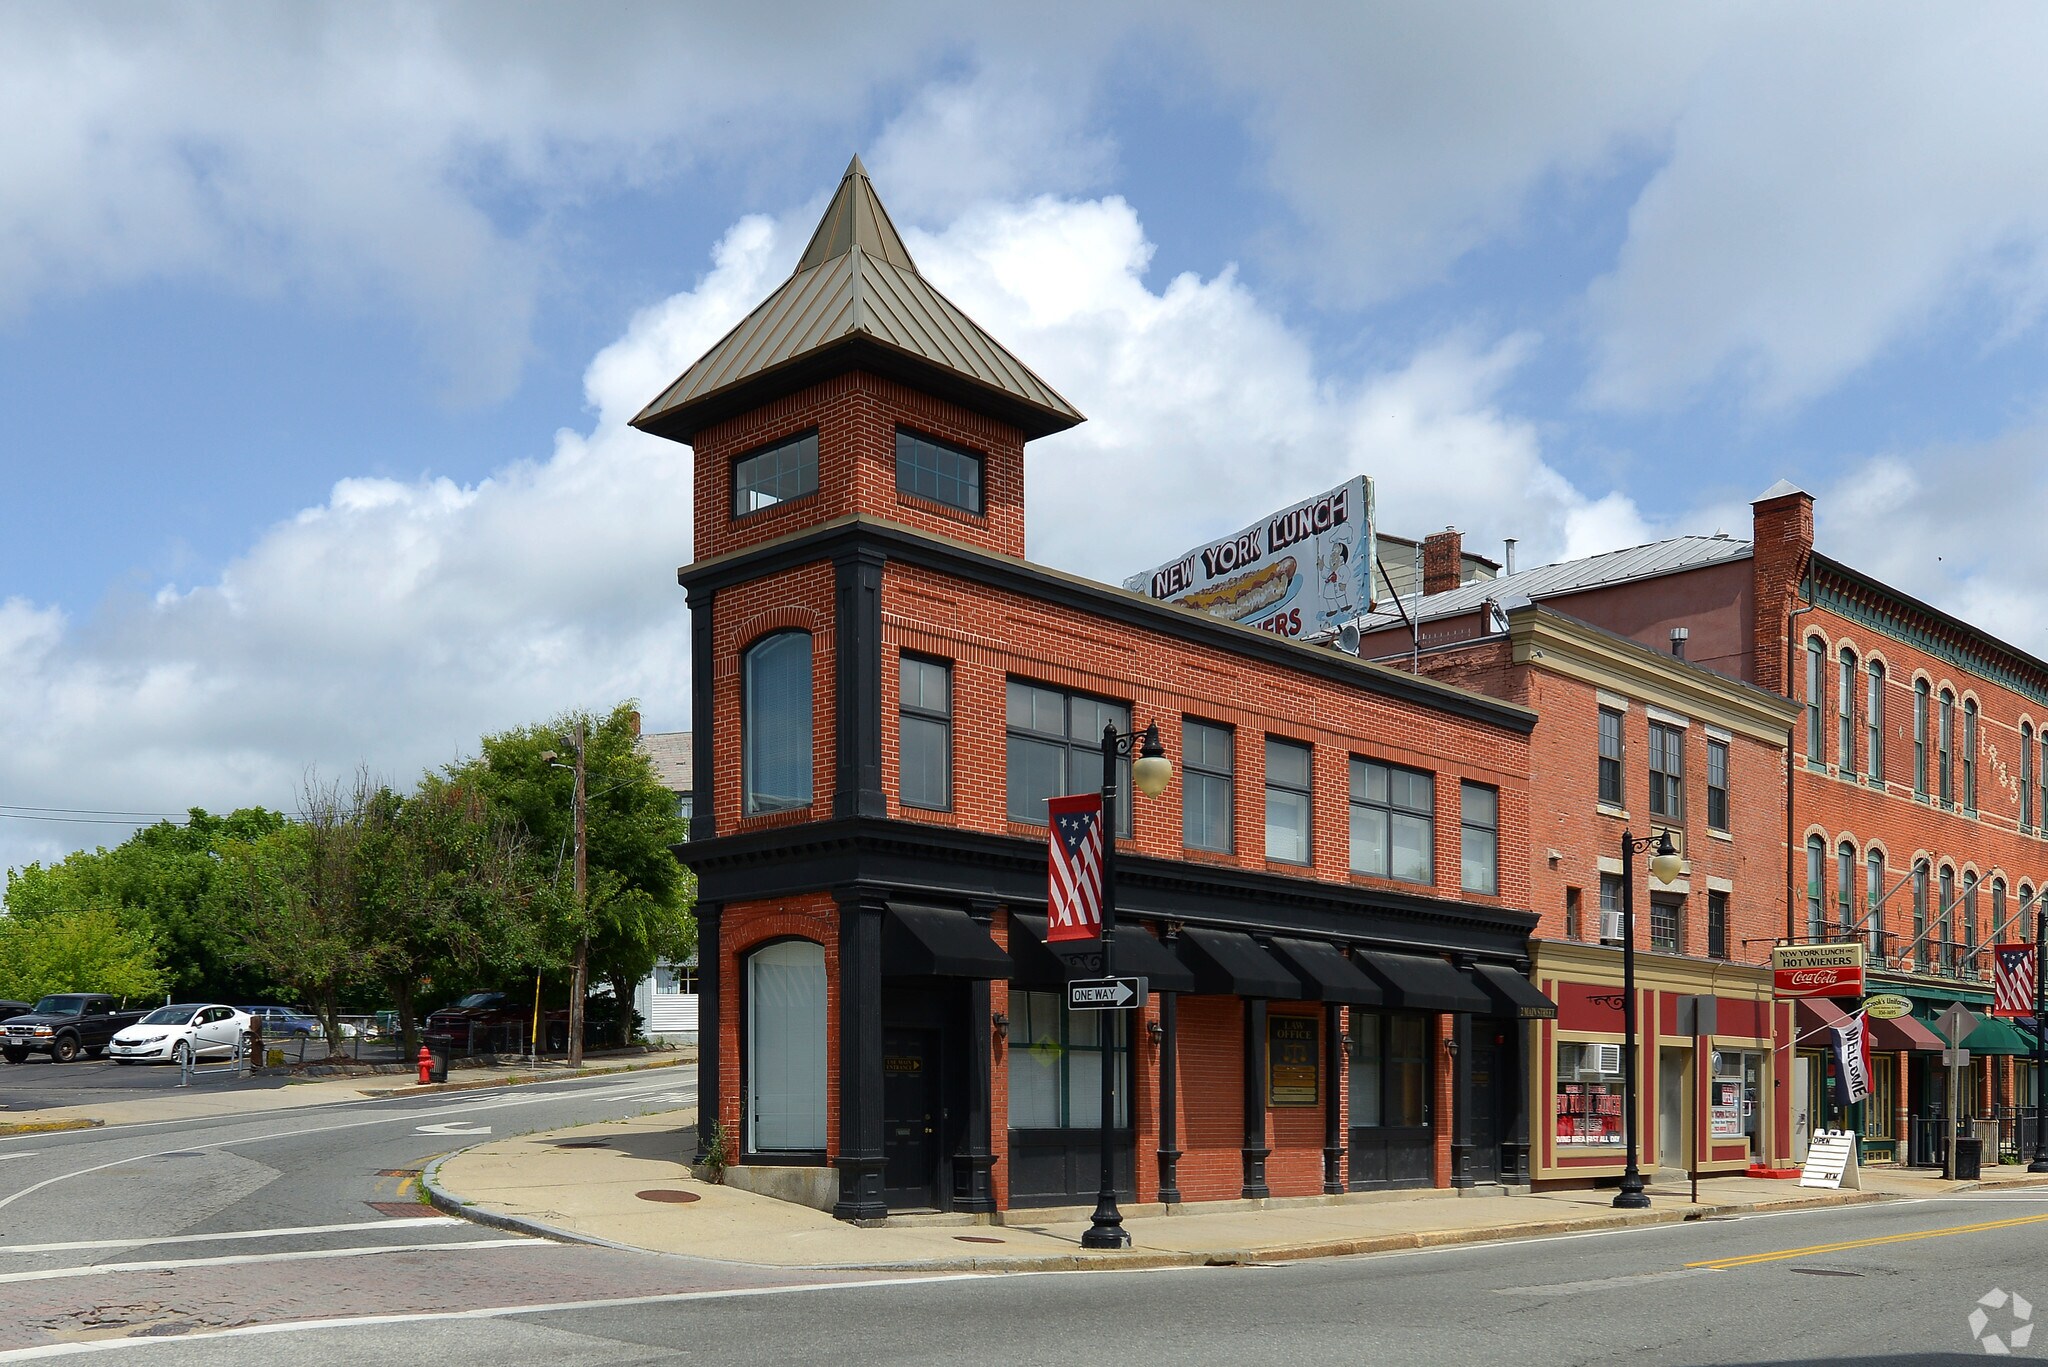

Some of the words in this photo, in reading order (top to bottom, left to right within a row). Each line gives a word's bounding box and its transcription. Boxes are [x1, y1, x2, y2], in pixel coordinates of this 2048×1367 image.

[1151, 554, 1196, 598] NEW
[1201, 527, 1262, 579] YORK
[1269, 488, 1349, 553] LUNCH
[1820, 948, 1845, 956] LUNCH
[1783, 958, 1803, 967] HOT
[1806, 956, 1852, 967] WIENERS
[1792, 969, 1839, 985] Coca-Cola
[1074, 990, 1092, 1001] ONE
[1095, 988, 1116, 1000] WAY
[1524, 1007, 1537, 1017] MAIN
[1537, 1007, 1555, 1018] STREET
[1284, 1020, 1305, 1030] LAW
[1277, 1029, 1312, 1039] OFFICE
[1845, 1026, 1867, 1098] WELCOME
